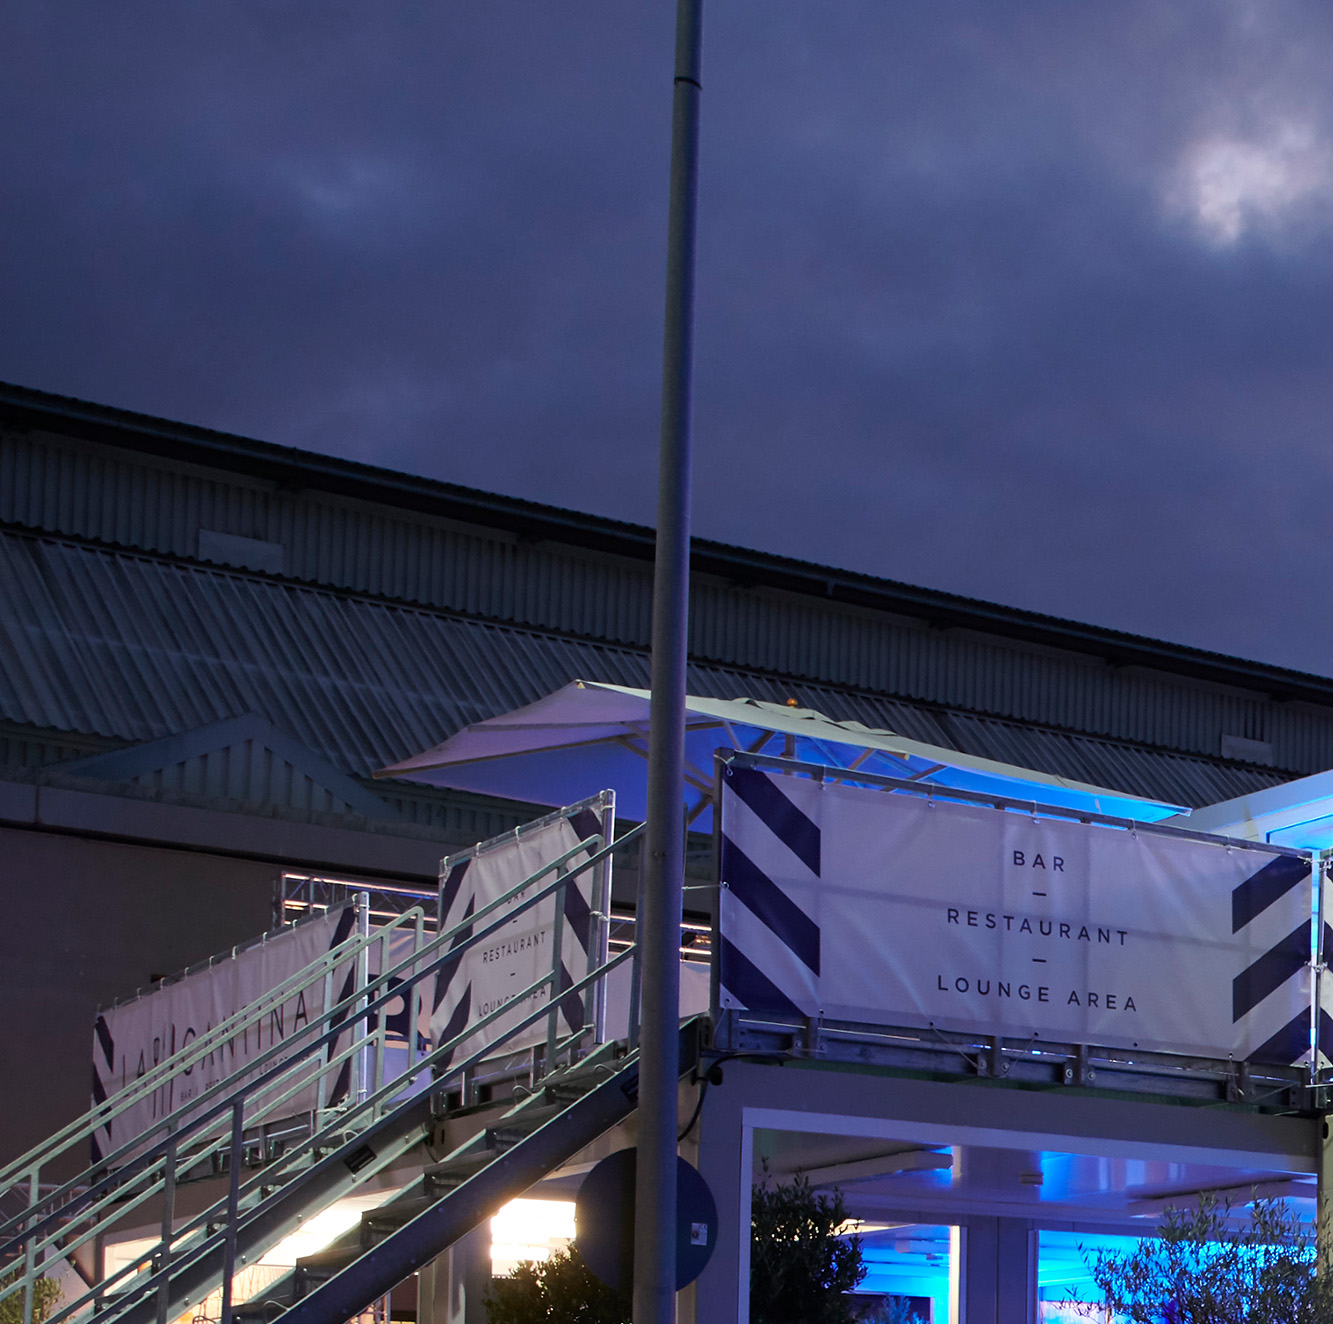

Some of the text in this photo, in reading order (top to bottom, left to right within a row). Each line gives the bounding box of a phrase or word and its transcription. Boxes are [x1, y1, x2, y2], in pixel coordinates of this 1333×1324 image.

[1013, 850, 1066, 873] BAR
[947, 907, 1130, 947] RESTAURANT
[482, 931, 546, 964] RESTAURANT
[936, 973, 1138, 1013] LOUNGE AREA
